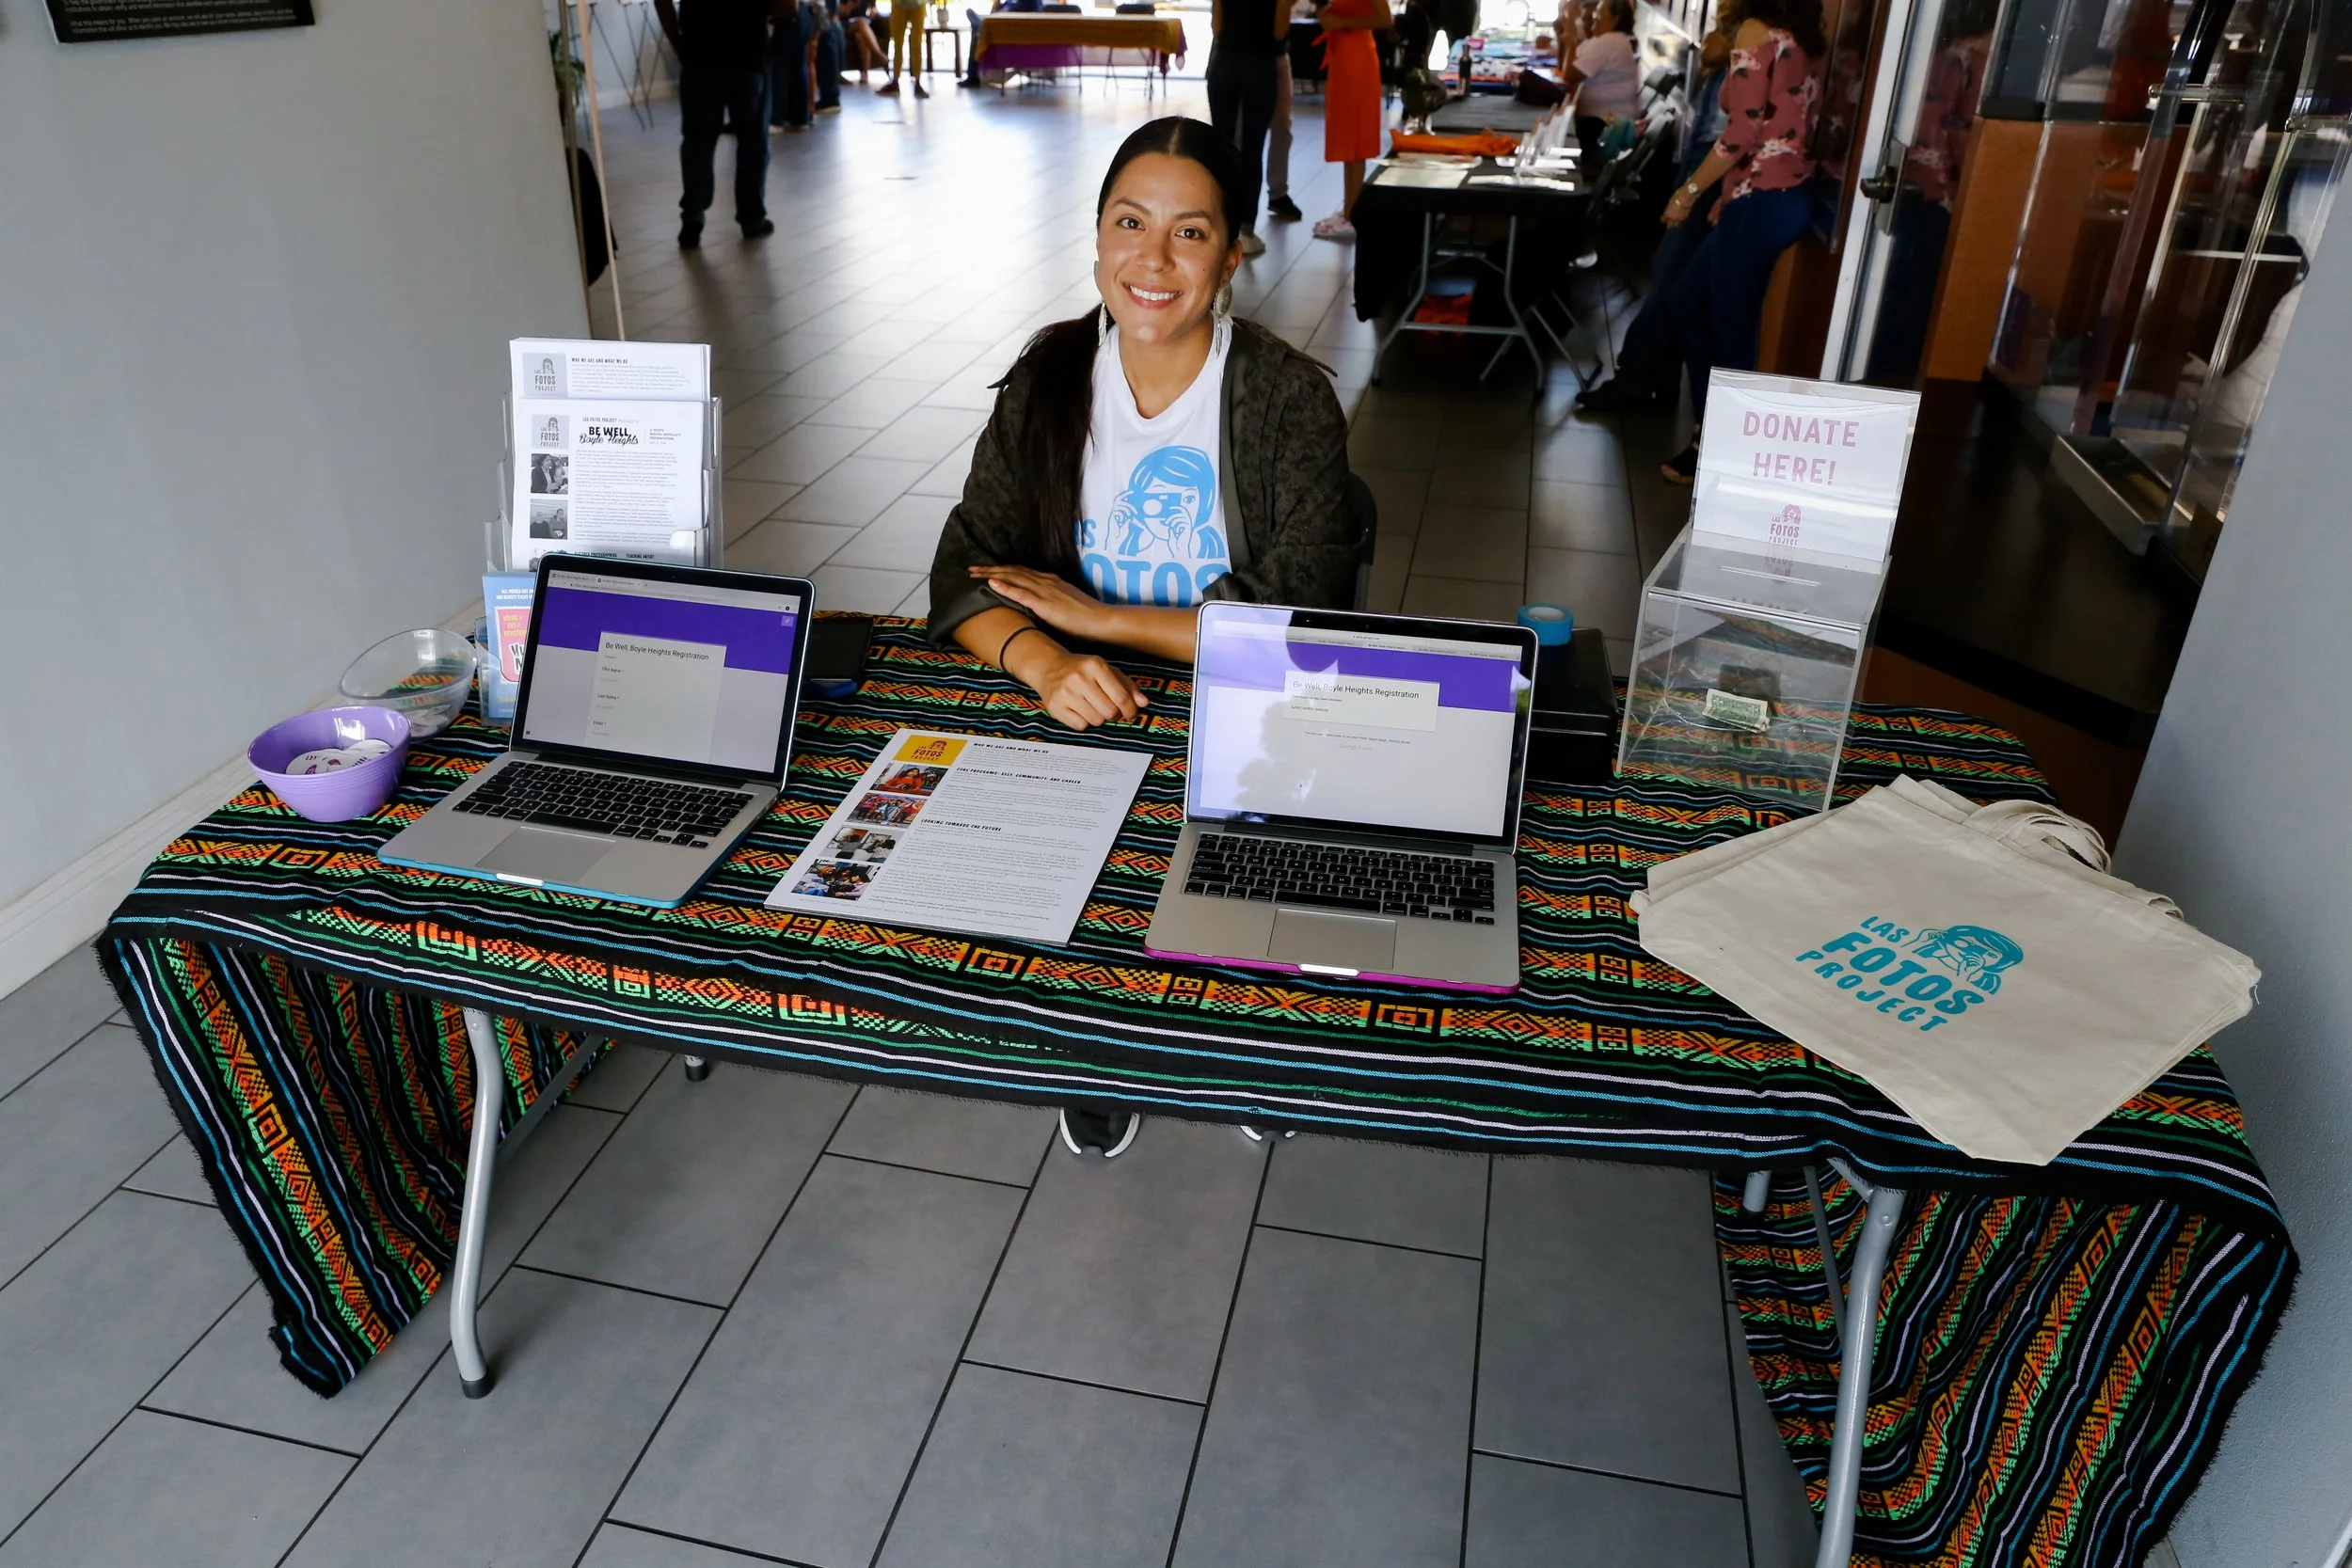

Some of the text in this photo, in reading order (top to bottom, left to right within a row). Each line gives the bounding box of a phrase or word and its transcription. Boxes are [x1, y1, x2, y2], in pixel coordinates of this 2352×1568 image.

[534, 374, 556, 386] FOTOS
[540, 432, 560, 441] FOTOS
[589, 426, 632, 437] BE WELL,
[1742, 410, 1860, 448] DONATE
[579, 433, 640, 448] Boyle Heights
[1753, 451, 1836, 486] HERE!
[1770, 523, 1800, 538] FOTOS
[1769, 535, 1798, 546] PROJECT
[629, 645, 647, 654] Boyle
[647, 647, 672, 657] Heights
[672, 651, 709, 660] Registration
[1293, 680, 1420, 700] Be Well, Boyle Heights Registration
[914, 749, 944, 757] FOTOS
[945, 820, 970, 829] TOWARDS
[1860, 915, 1911, 943] LAS
[1821, 930, 1985, 1016] FOTOS
[1794, 949, 1948, 1032] PROJECT
